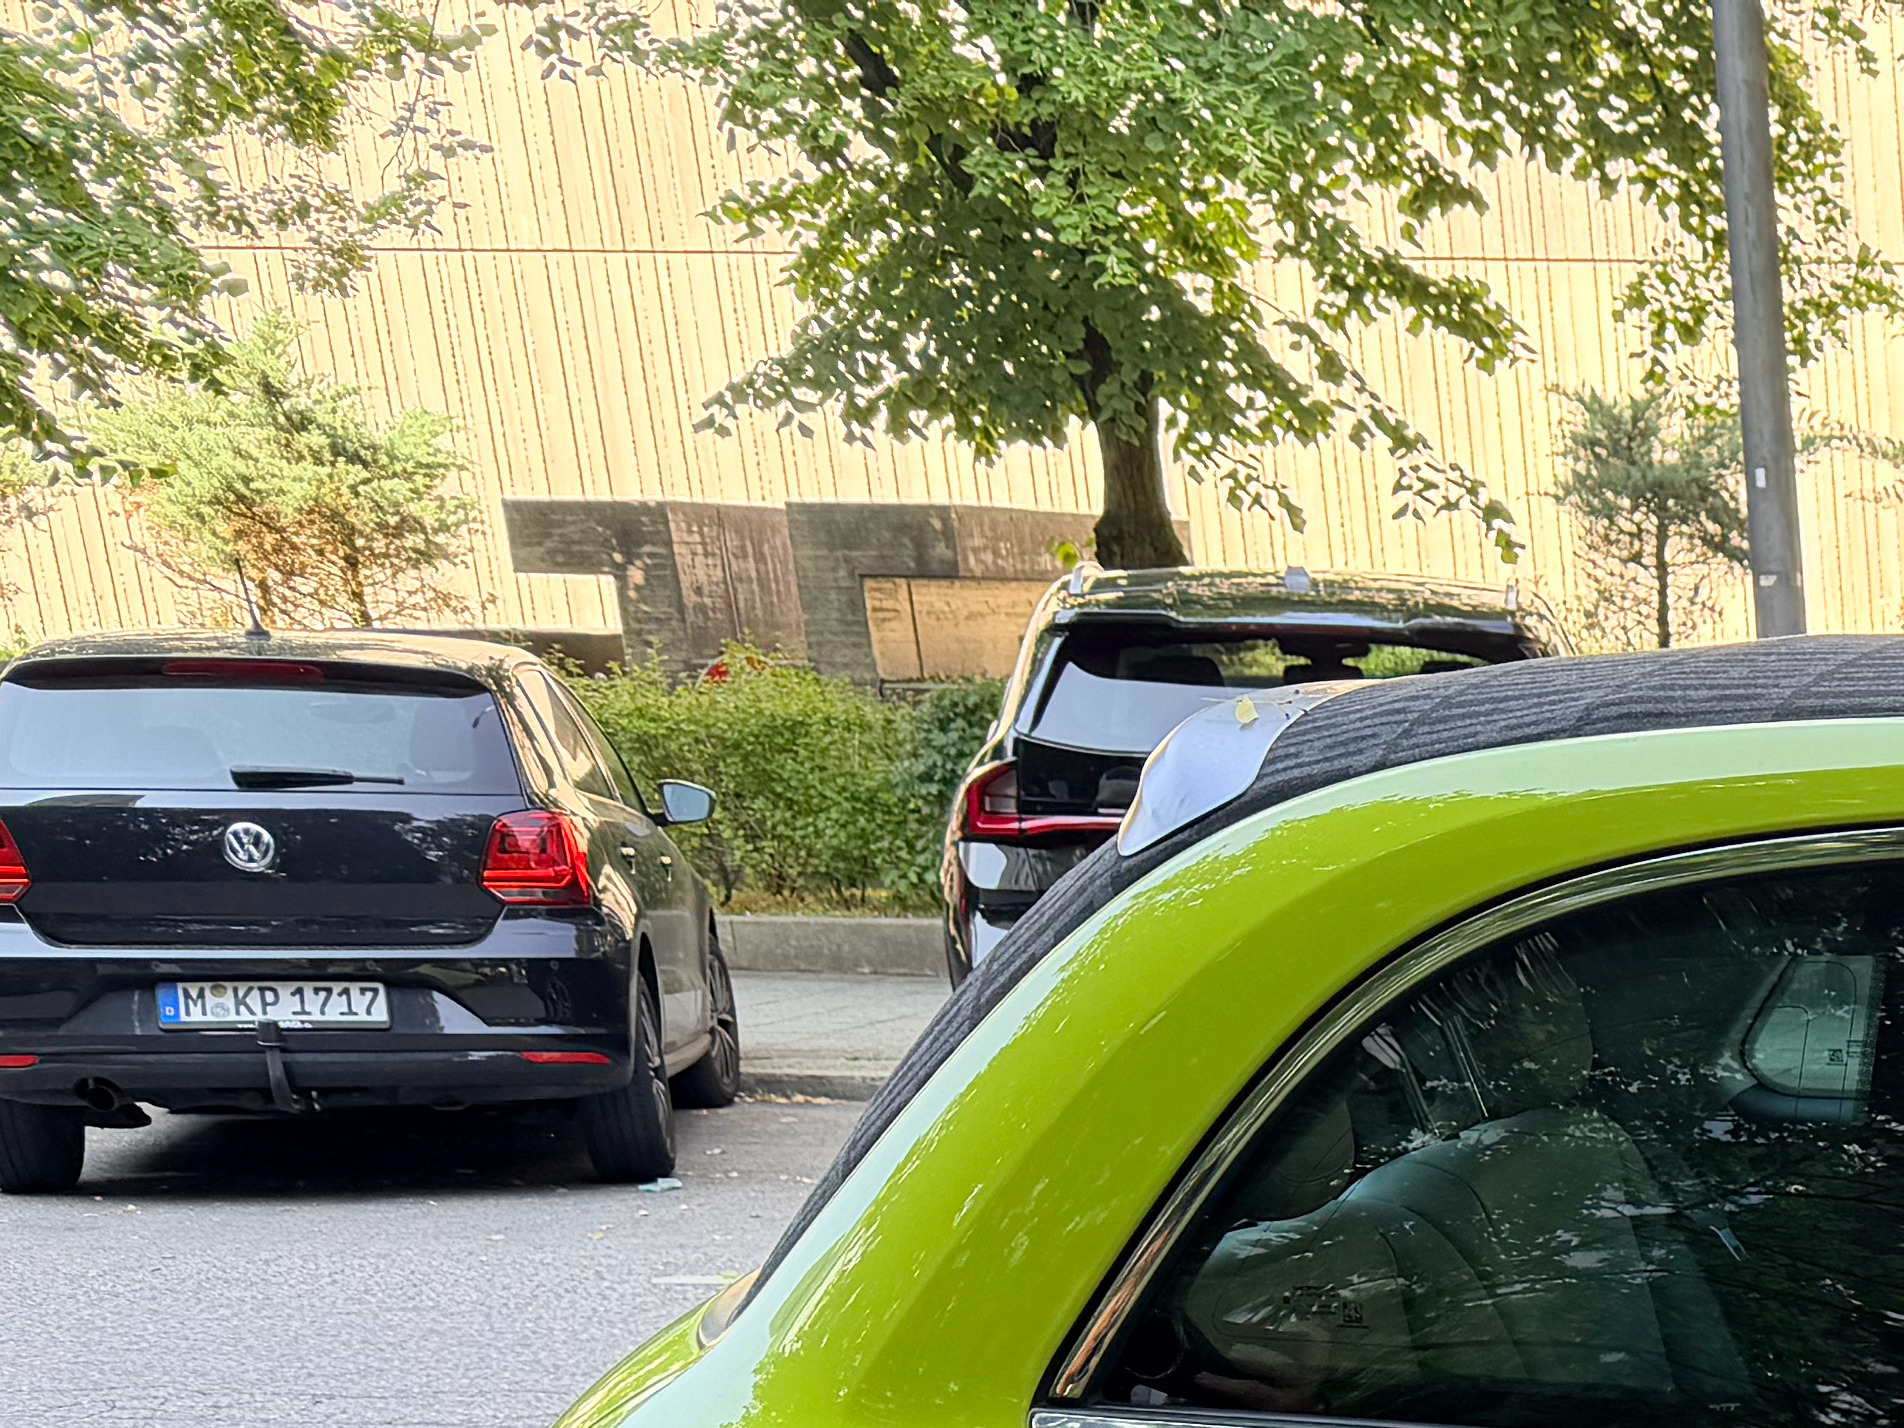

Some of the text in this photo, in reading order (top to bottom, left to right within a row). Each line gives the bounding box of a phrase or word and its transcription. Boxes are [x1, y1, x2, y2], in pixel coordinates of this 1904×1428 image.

[182, 986, 208, 1017] M
[233, 986, 281, 1016] KP
[290, 986, 380, 1016] 1717
